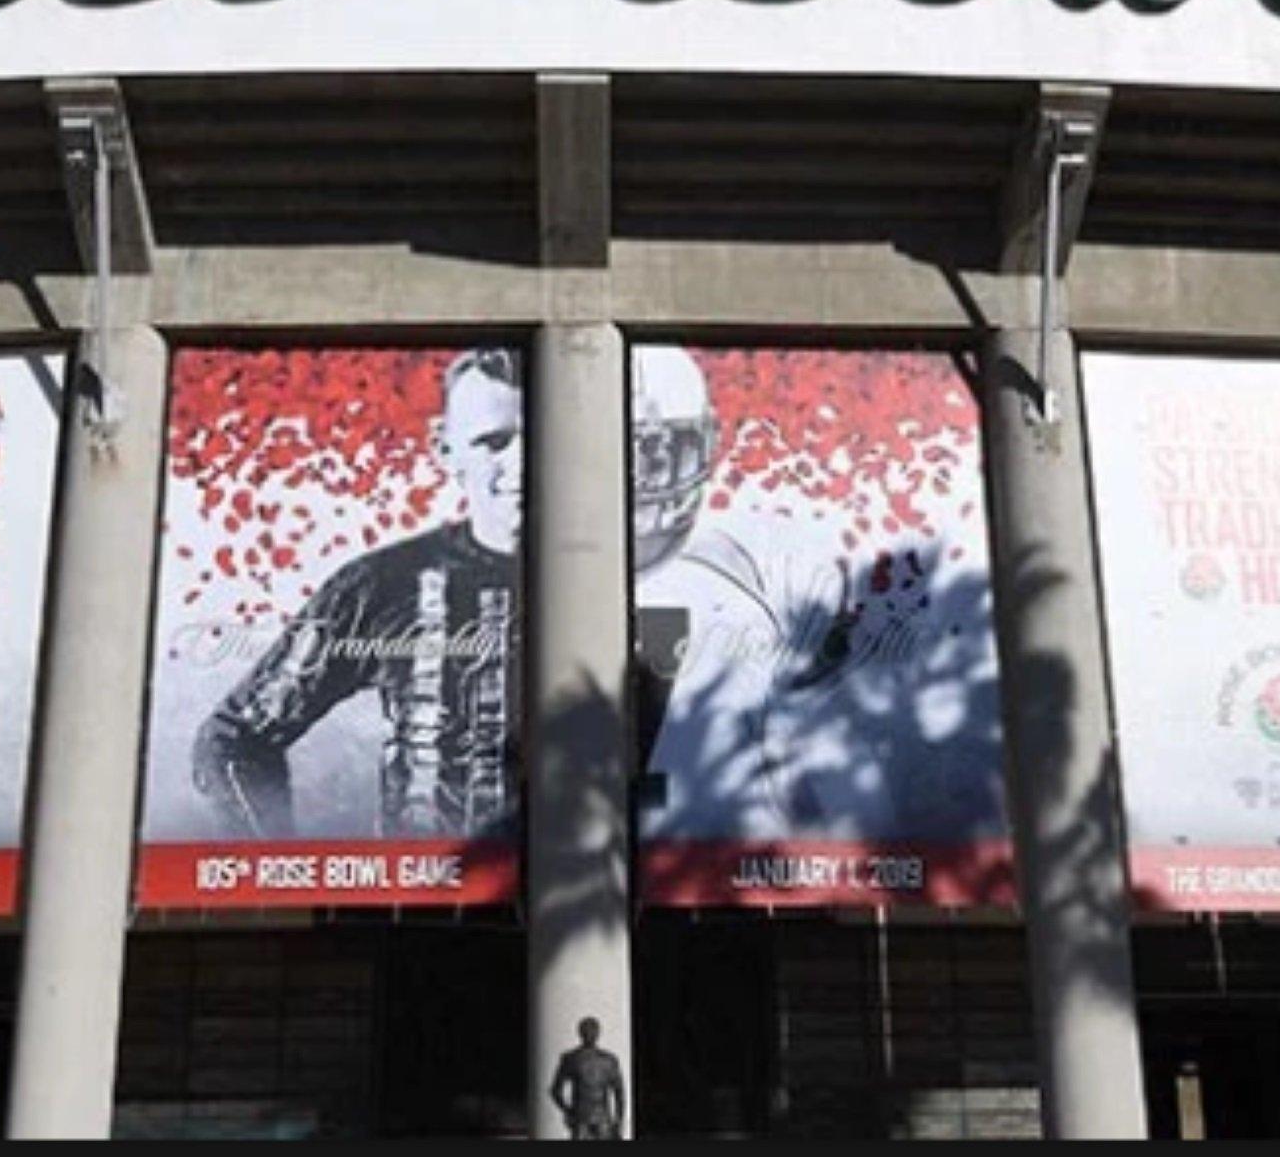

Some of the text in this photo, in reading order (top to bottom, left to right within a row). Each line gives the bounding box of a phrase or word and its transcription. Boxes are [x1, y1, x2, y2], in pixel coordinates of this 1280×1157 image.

[256, 856, 317, 889] ROSE
[322, 856, 392, 888] BOWL
[396, 856, 463, 888] GAME
[732, 856, 840, 888] JANUARY
